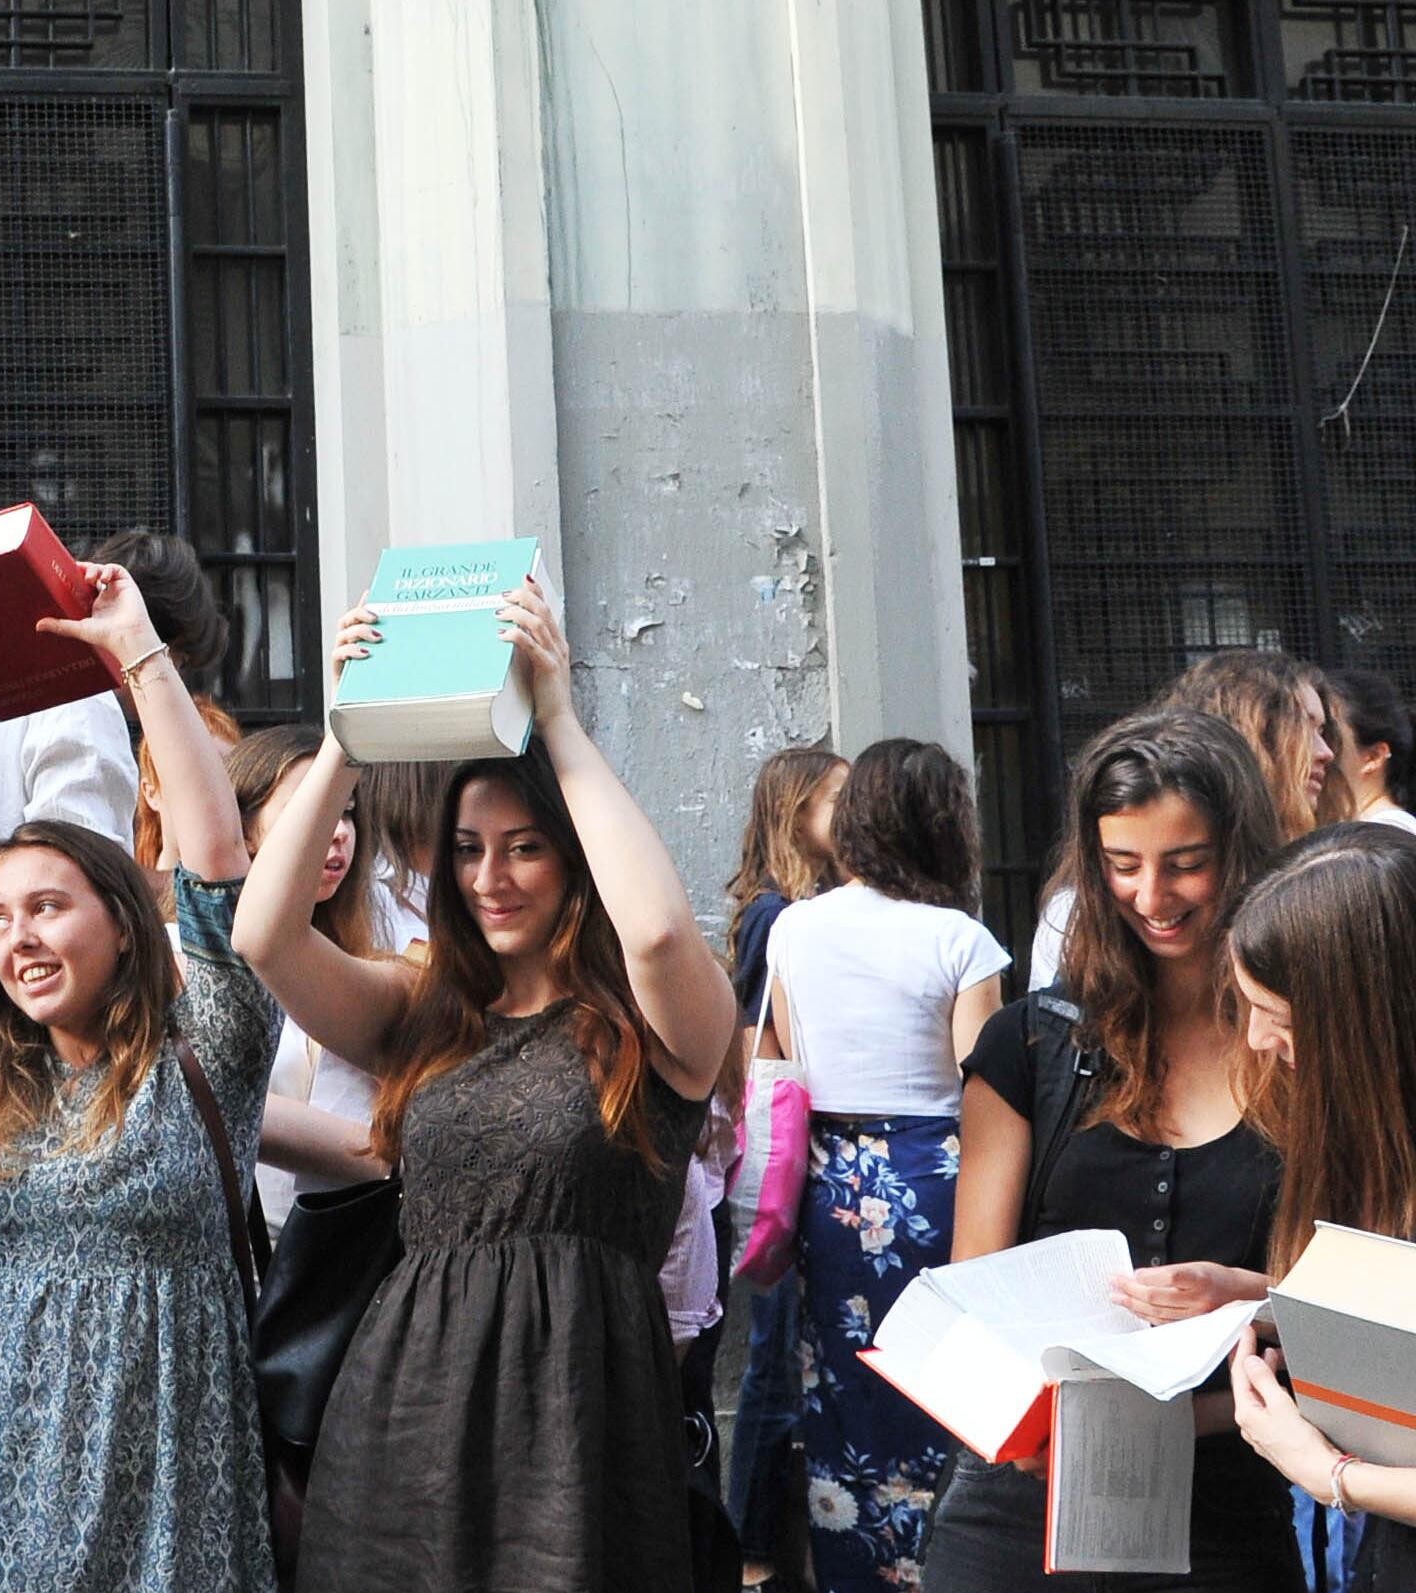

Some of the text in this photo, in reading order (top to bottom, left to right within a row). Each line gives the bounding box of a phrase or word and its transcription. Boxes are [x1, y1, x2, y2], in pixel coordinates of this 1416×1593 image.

[401, 560, 496, 579] IL GRANDE
[393, 571, 499, 591] DIZIONARIO
[396, 584, 491, 600] GARZANTI
